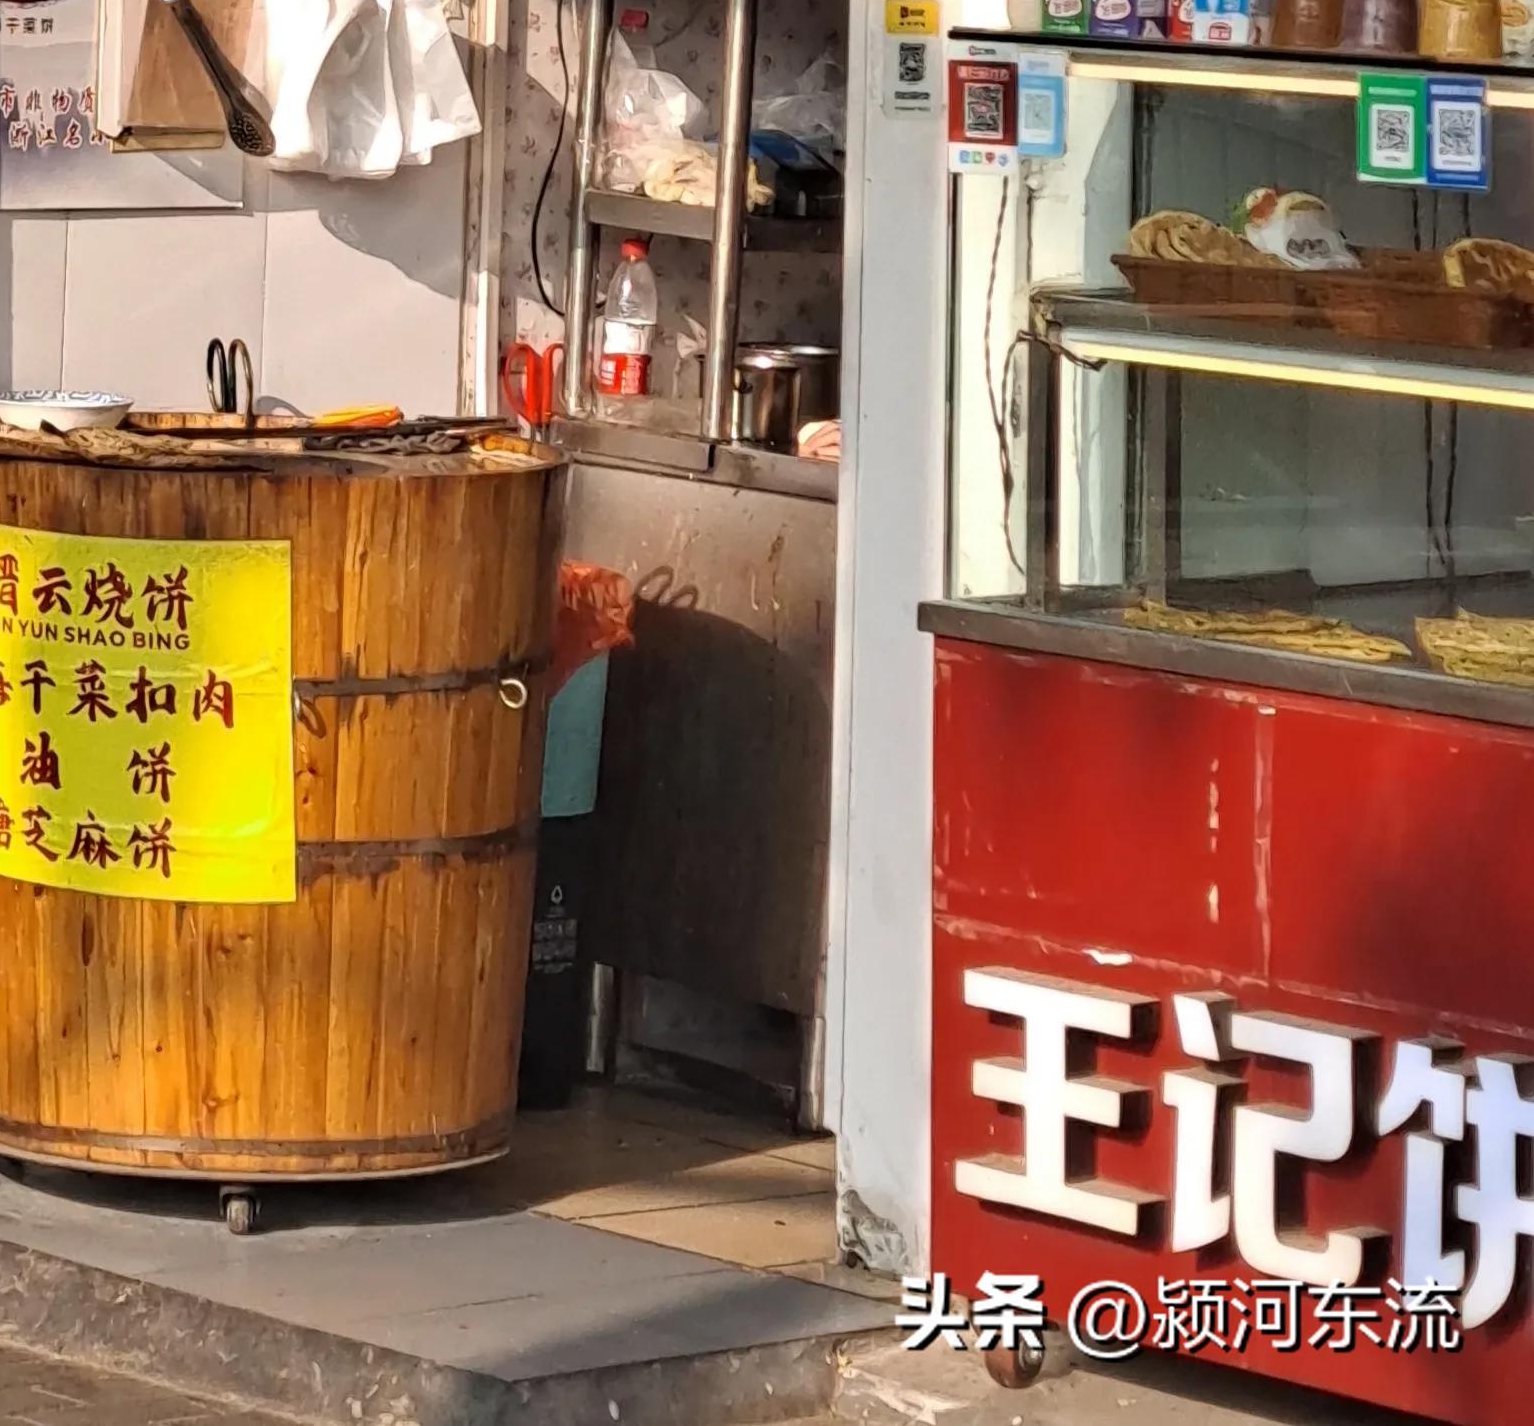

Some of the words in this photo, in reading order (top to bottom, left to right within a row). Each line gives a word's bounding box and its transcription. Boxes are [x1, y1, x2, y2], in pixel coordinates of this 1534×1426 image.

[19, 619, 58, 641] YUN
[64, 625, 125, 647] SHAO
[132, 632, 191, 650] BING
